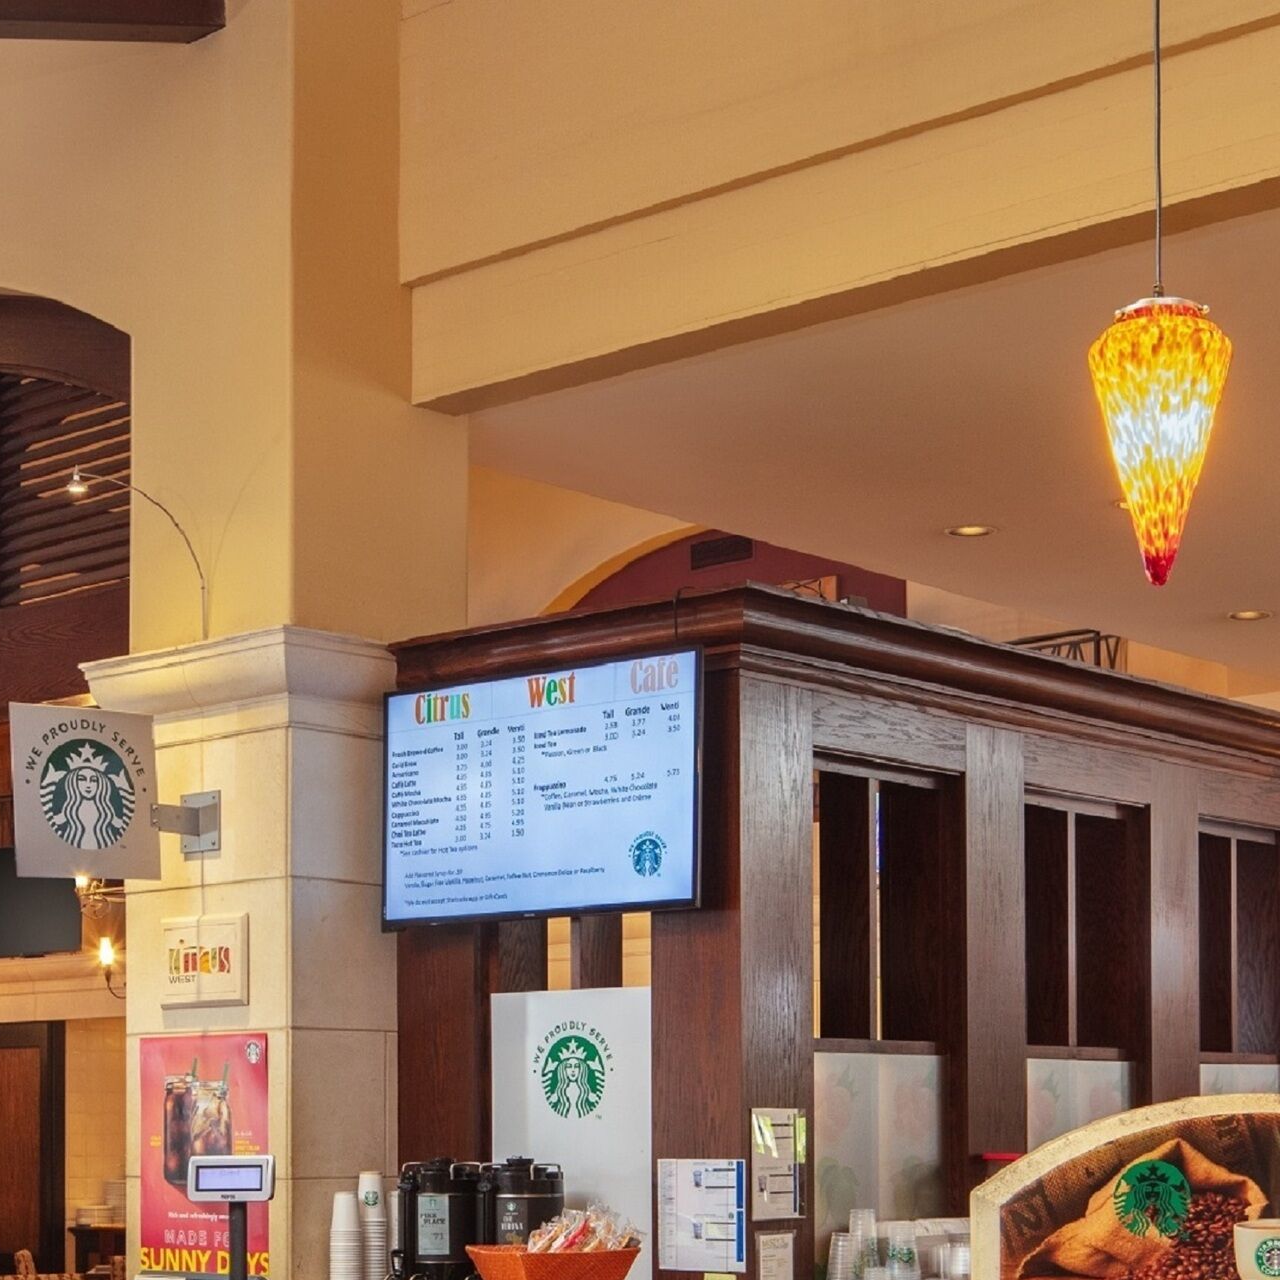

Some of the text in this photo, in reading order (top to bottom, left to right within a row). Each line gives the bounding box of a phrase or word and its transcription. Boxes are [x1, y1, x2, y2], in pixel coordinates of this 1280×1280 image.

[415, 656, 679, 725] Citrus West Café
[602, 709, 614, 719] Tall
[625, 705, 651, 717] Grande
[453, 731, 465, 741] Tall
[477, 726, 500, 738] Grande
[25, 719, 146, 777] WE PROUDLY SERVE
[168, 975, 196, 984] WEST
[533, 1021, 613, 1063] WE PROUDLY SERVE
[164, 1229, 207, 1246] MADE
[140, 1247, 269, 1275] SUNNY DYS
